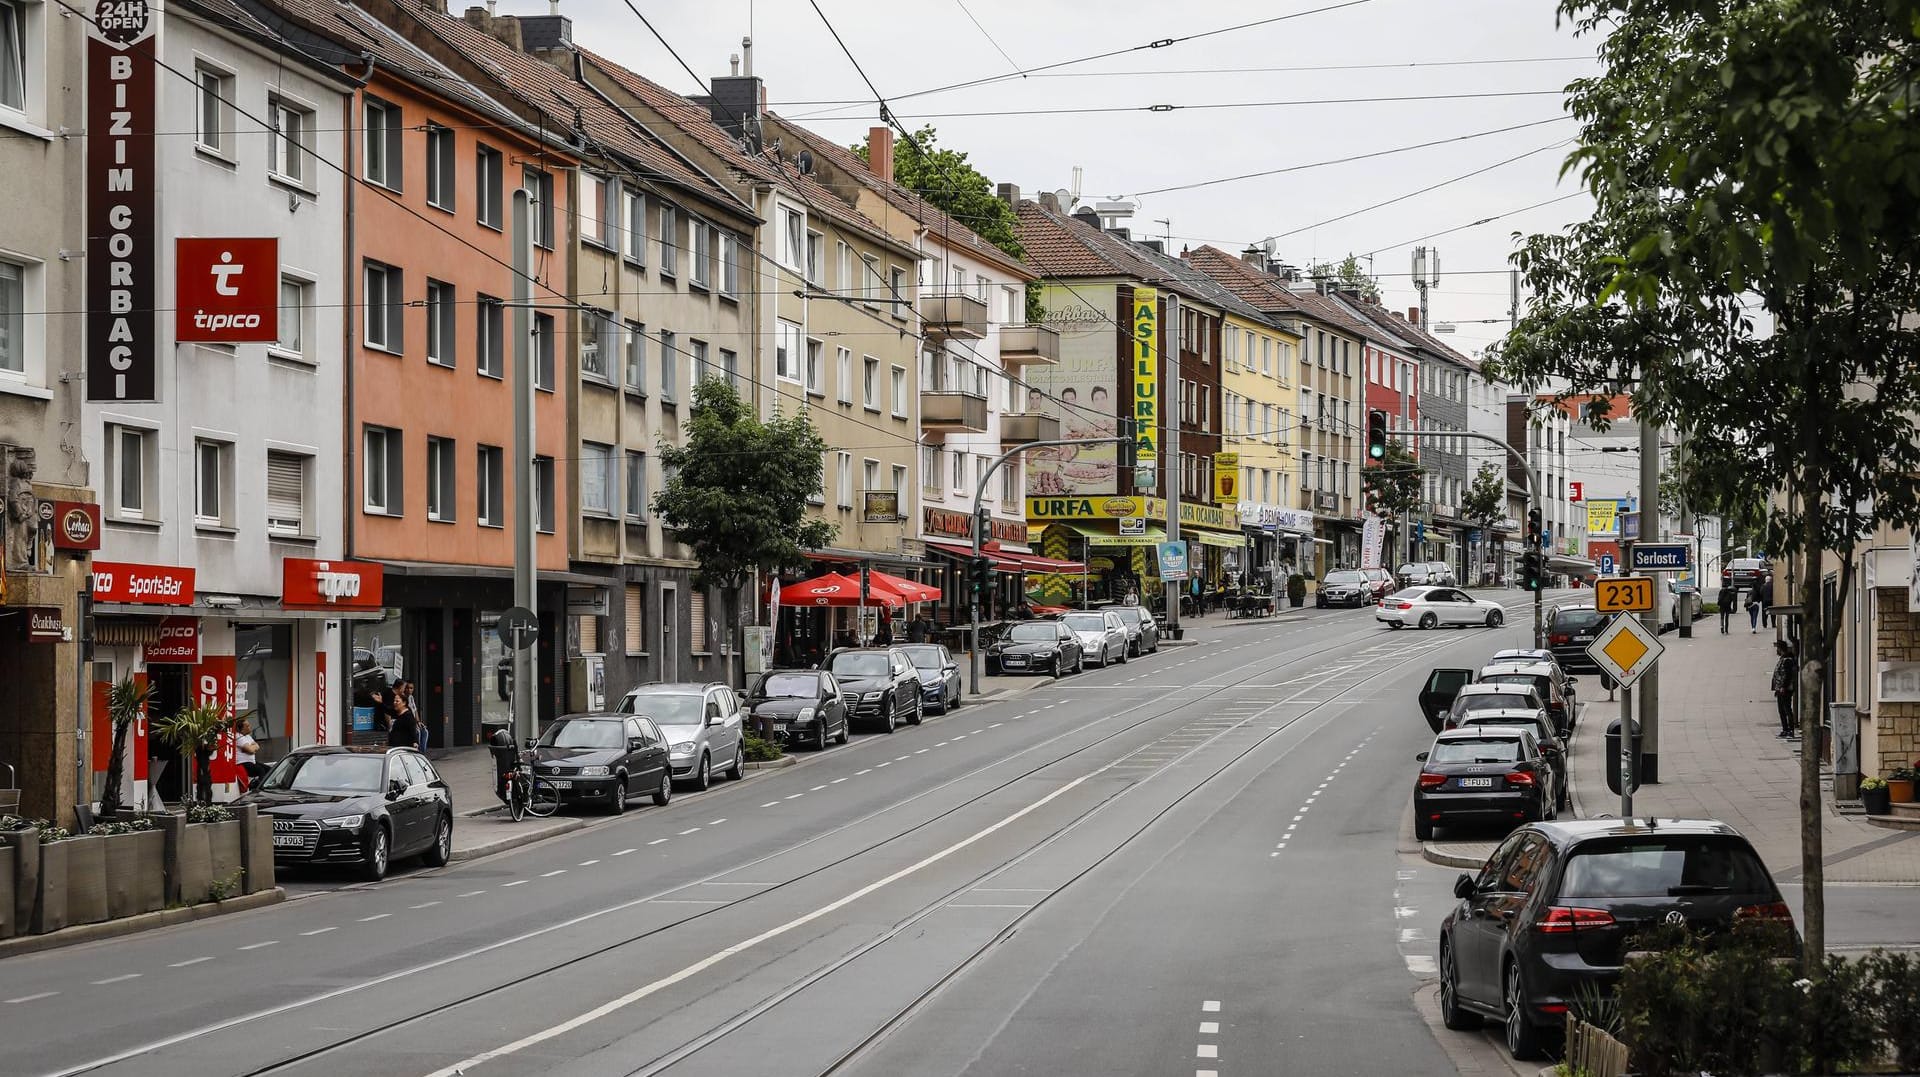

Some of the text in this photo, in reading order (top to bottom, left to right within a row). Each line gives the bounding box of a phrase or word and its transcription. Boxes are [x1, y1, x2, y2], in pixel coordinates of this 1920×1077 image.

[101, 2, 143, 18] 24H
[101, 18, 143, 29] OPEN
[108, 56, 134, 398] BIZIM CORBACI
[193, 309, 261, 331] tipico
[1136, 383, 1155, 450] URFA
[1033, 499, 1094, 516] URFA
[1136, 519, 1143, 528] P
[1604, 557, 1611, 572] P
[1636, 551, 1680, 565] Serlostr.
[129, 574, 182, 598] SportsBar
[1606, 585, 1644, 606] 231
[147, 647, 195, 656] SportsBar
